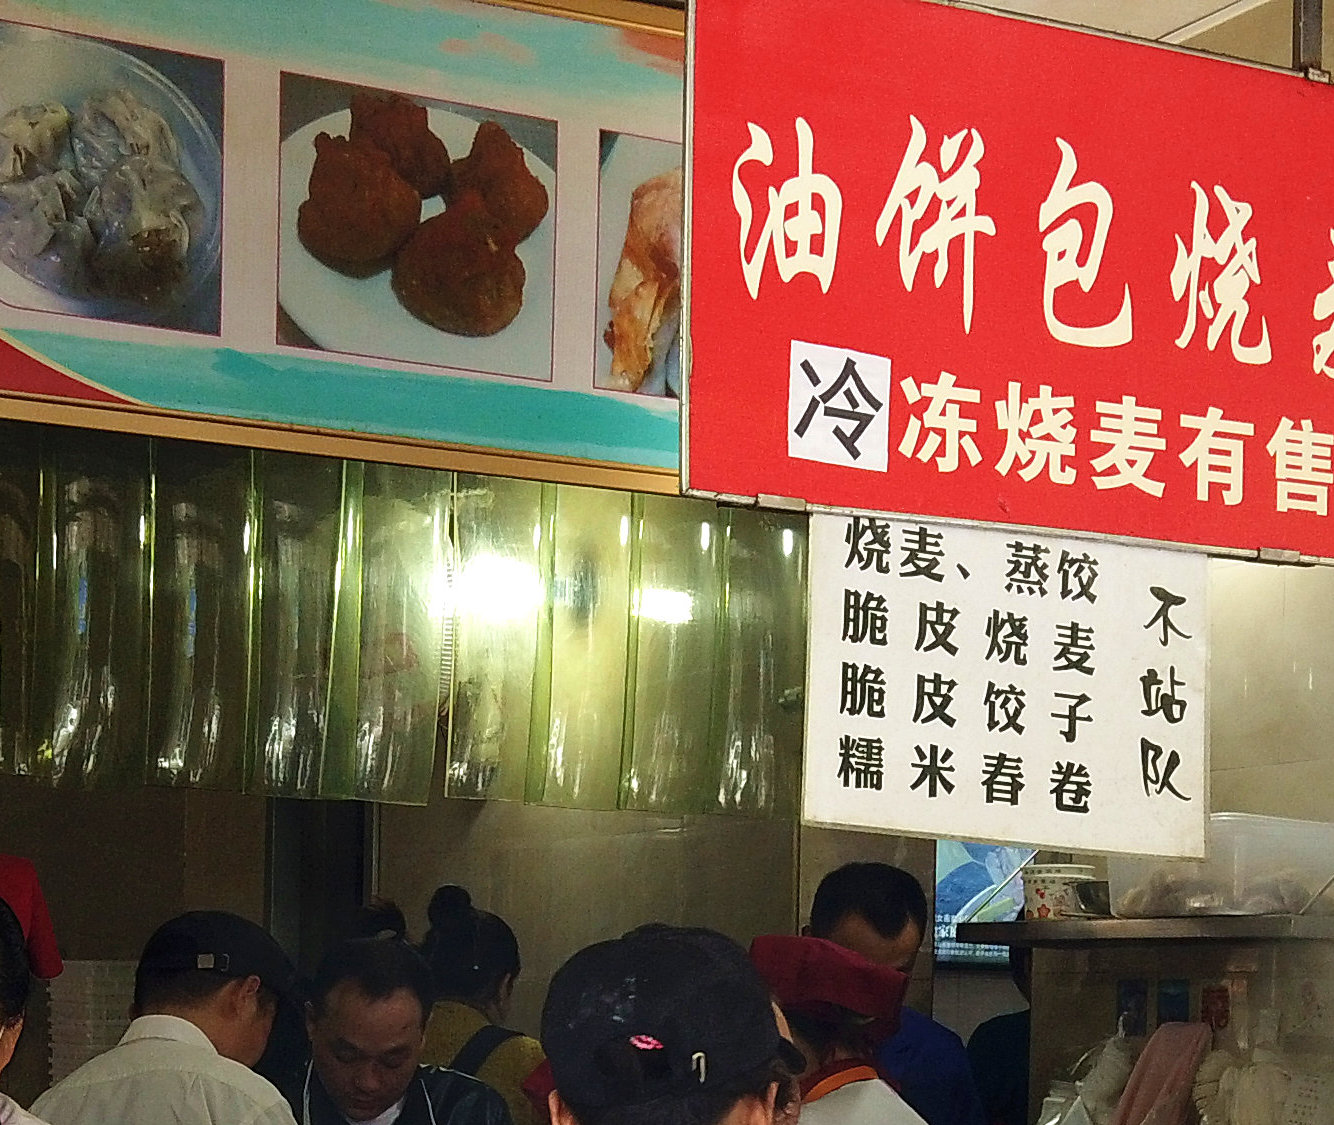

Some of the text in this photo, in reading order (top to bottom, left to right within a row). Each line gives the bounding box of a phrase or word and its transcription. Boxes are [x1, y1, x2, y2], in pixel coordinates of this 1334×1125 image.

[844, 516, 1100, 606] 烧麦、蒸饺
[840, 587, 1097, 677] 脆皮烧麦
[838, 661, 1094, 744] 脆皮饺子
[1138, 585, 1194, 803] 不站队
[836, 734, 1093, 816] 糯米春卷
